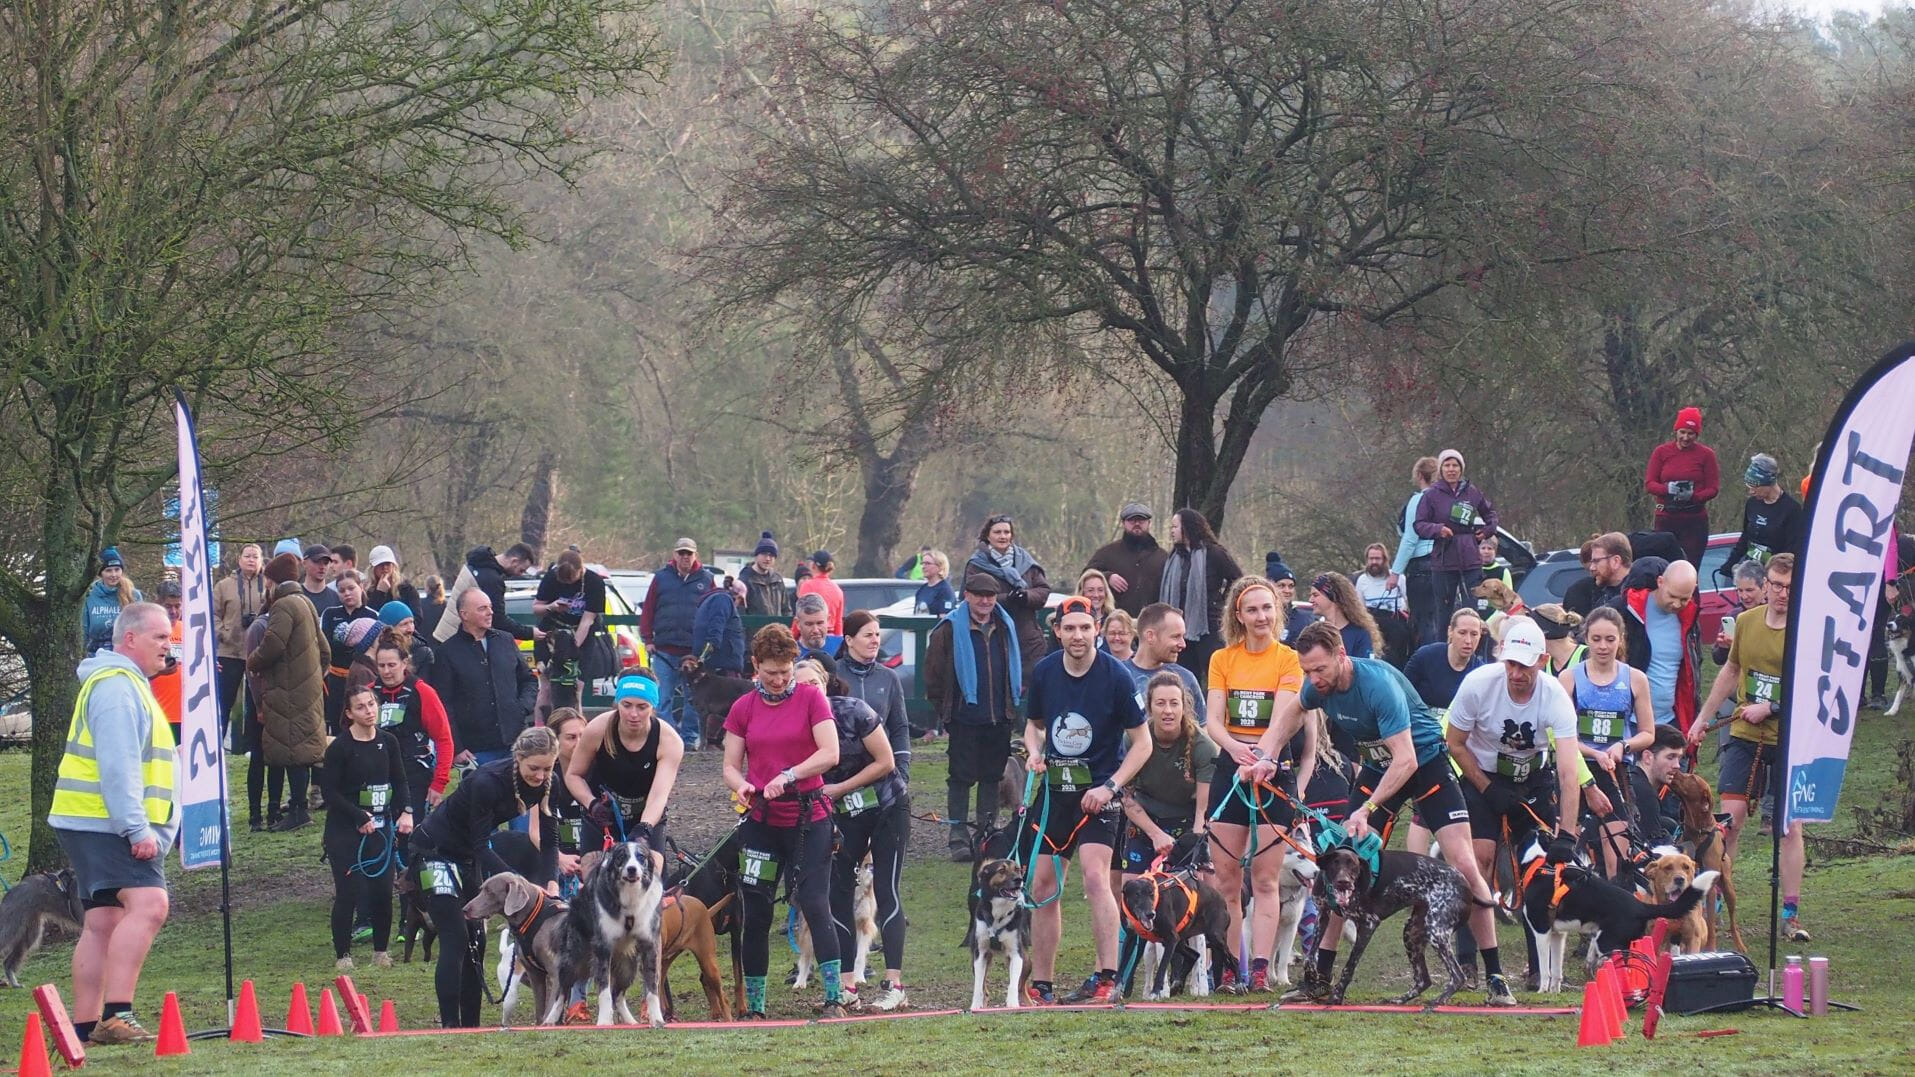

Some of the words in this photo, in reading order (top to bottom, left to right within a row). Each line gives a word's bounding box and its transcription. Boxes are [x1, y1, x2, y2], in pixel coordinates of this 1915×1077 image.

[1461, 507, 1472, 521] 72
[1817, 430, 1904, 736] START
[1755, 680, 1773, 699] 24
[1238, 699, 1258, 719] 43
[1592, 718, 1611, 736] 88
[1062, 767, 1072, 783] 4
[1512, 762, 1531, 777] 79
[371, 791, 386, 806] 89
[843, 792, 864, 810] 60
[745, 858, 761, 877] 14
